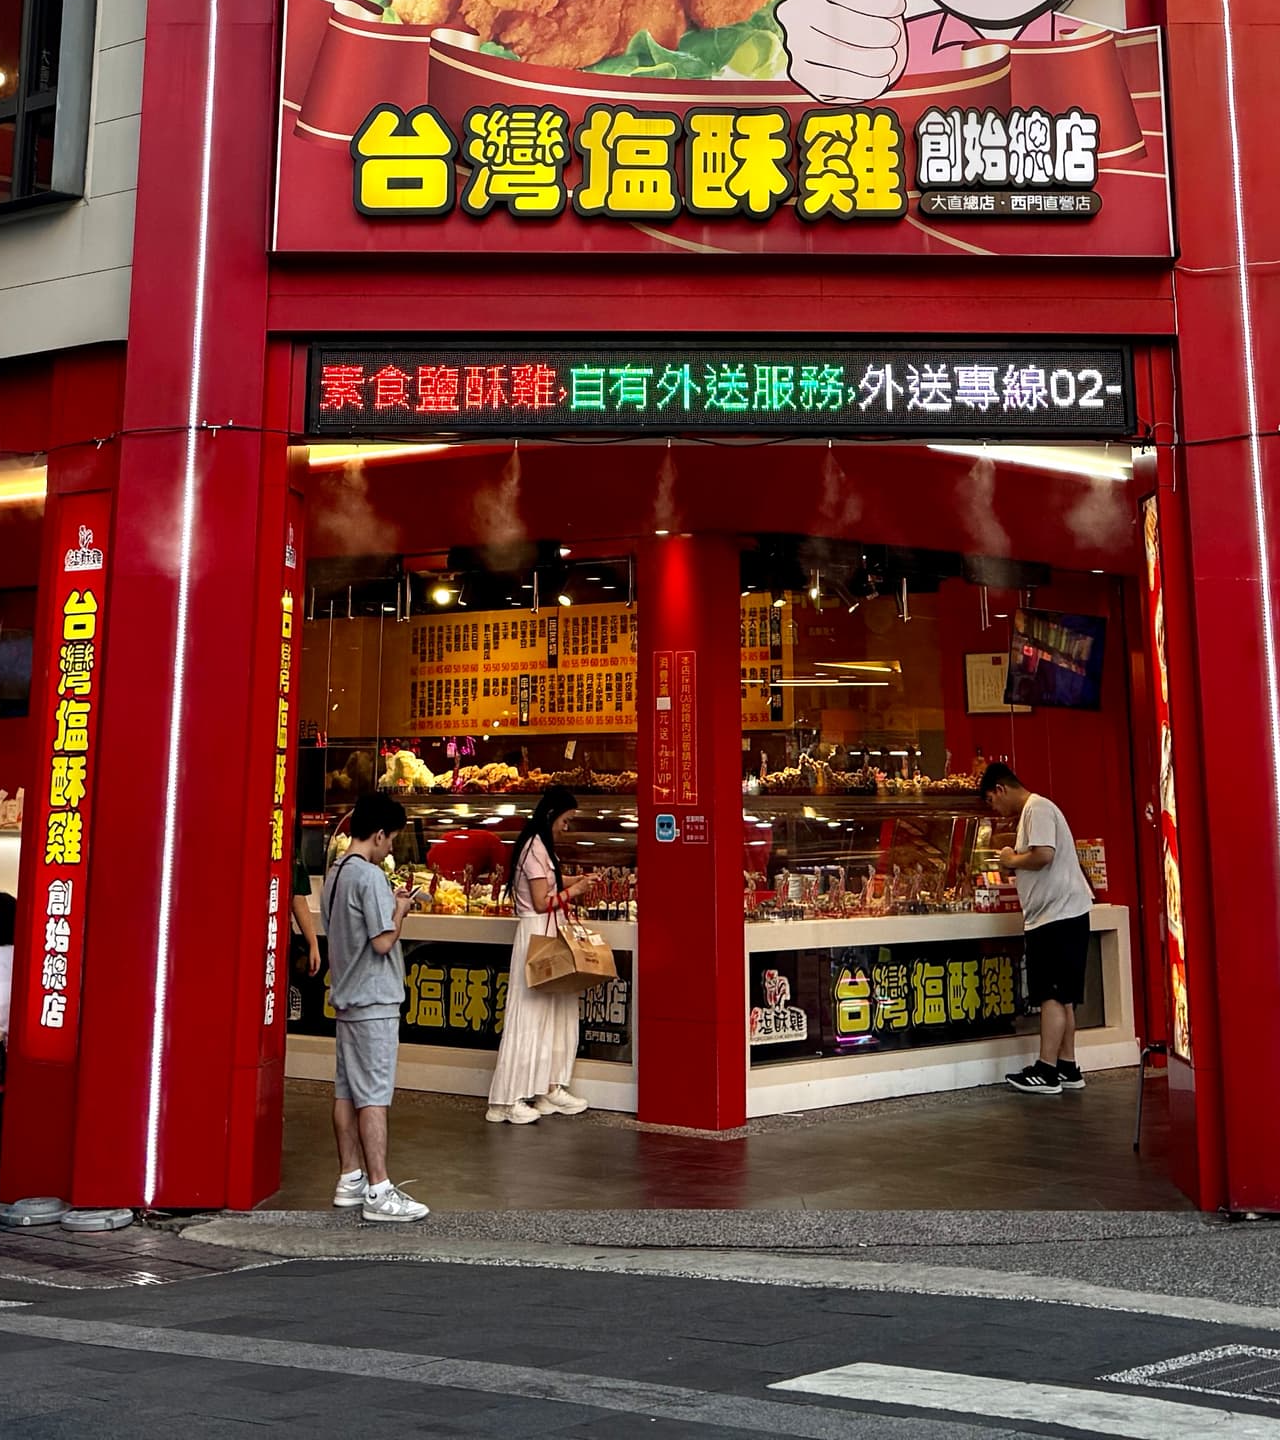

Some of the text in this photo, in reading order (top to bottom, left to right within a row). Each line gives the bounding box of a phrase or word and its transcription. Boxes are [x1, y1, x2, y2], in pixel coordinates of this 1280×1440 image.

[351, 104, 1100, 220] 台灣塩酥雞 創始總店
[45, 589, 98, 865] 台灣塩酥雞
[40, 879, 73, 1030] 創始總店
[835, 957, 1015, 1035] 台灣塩酥雞
